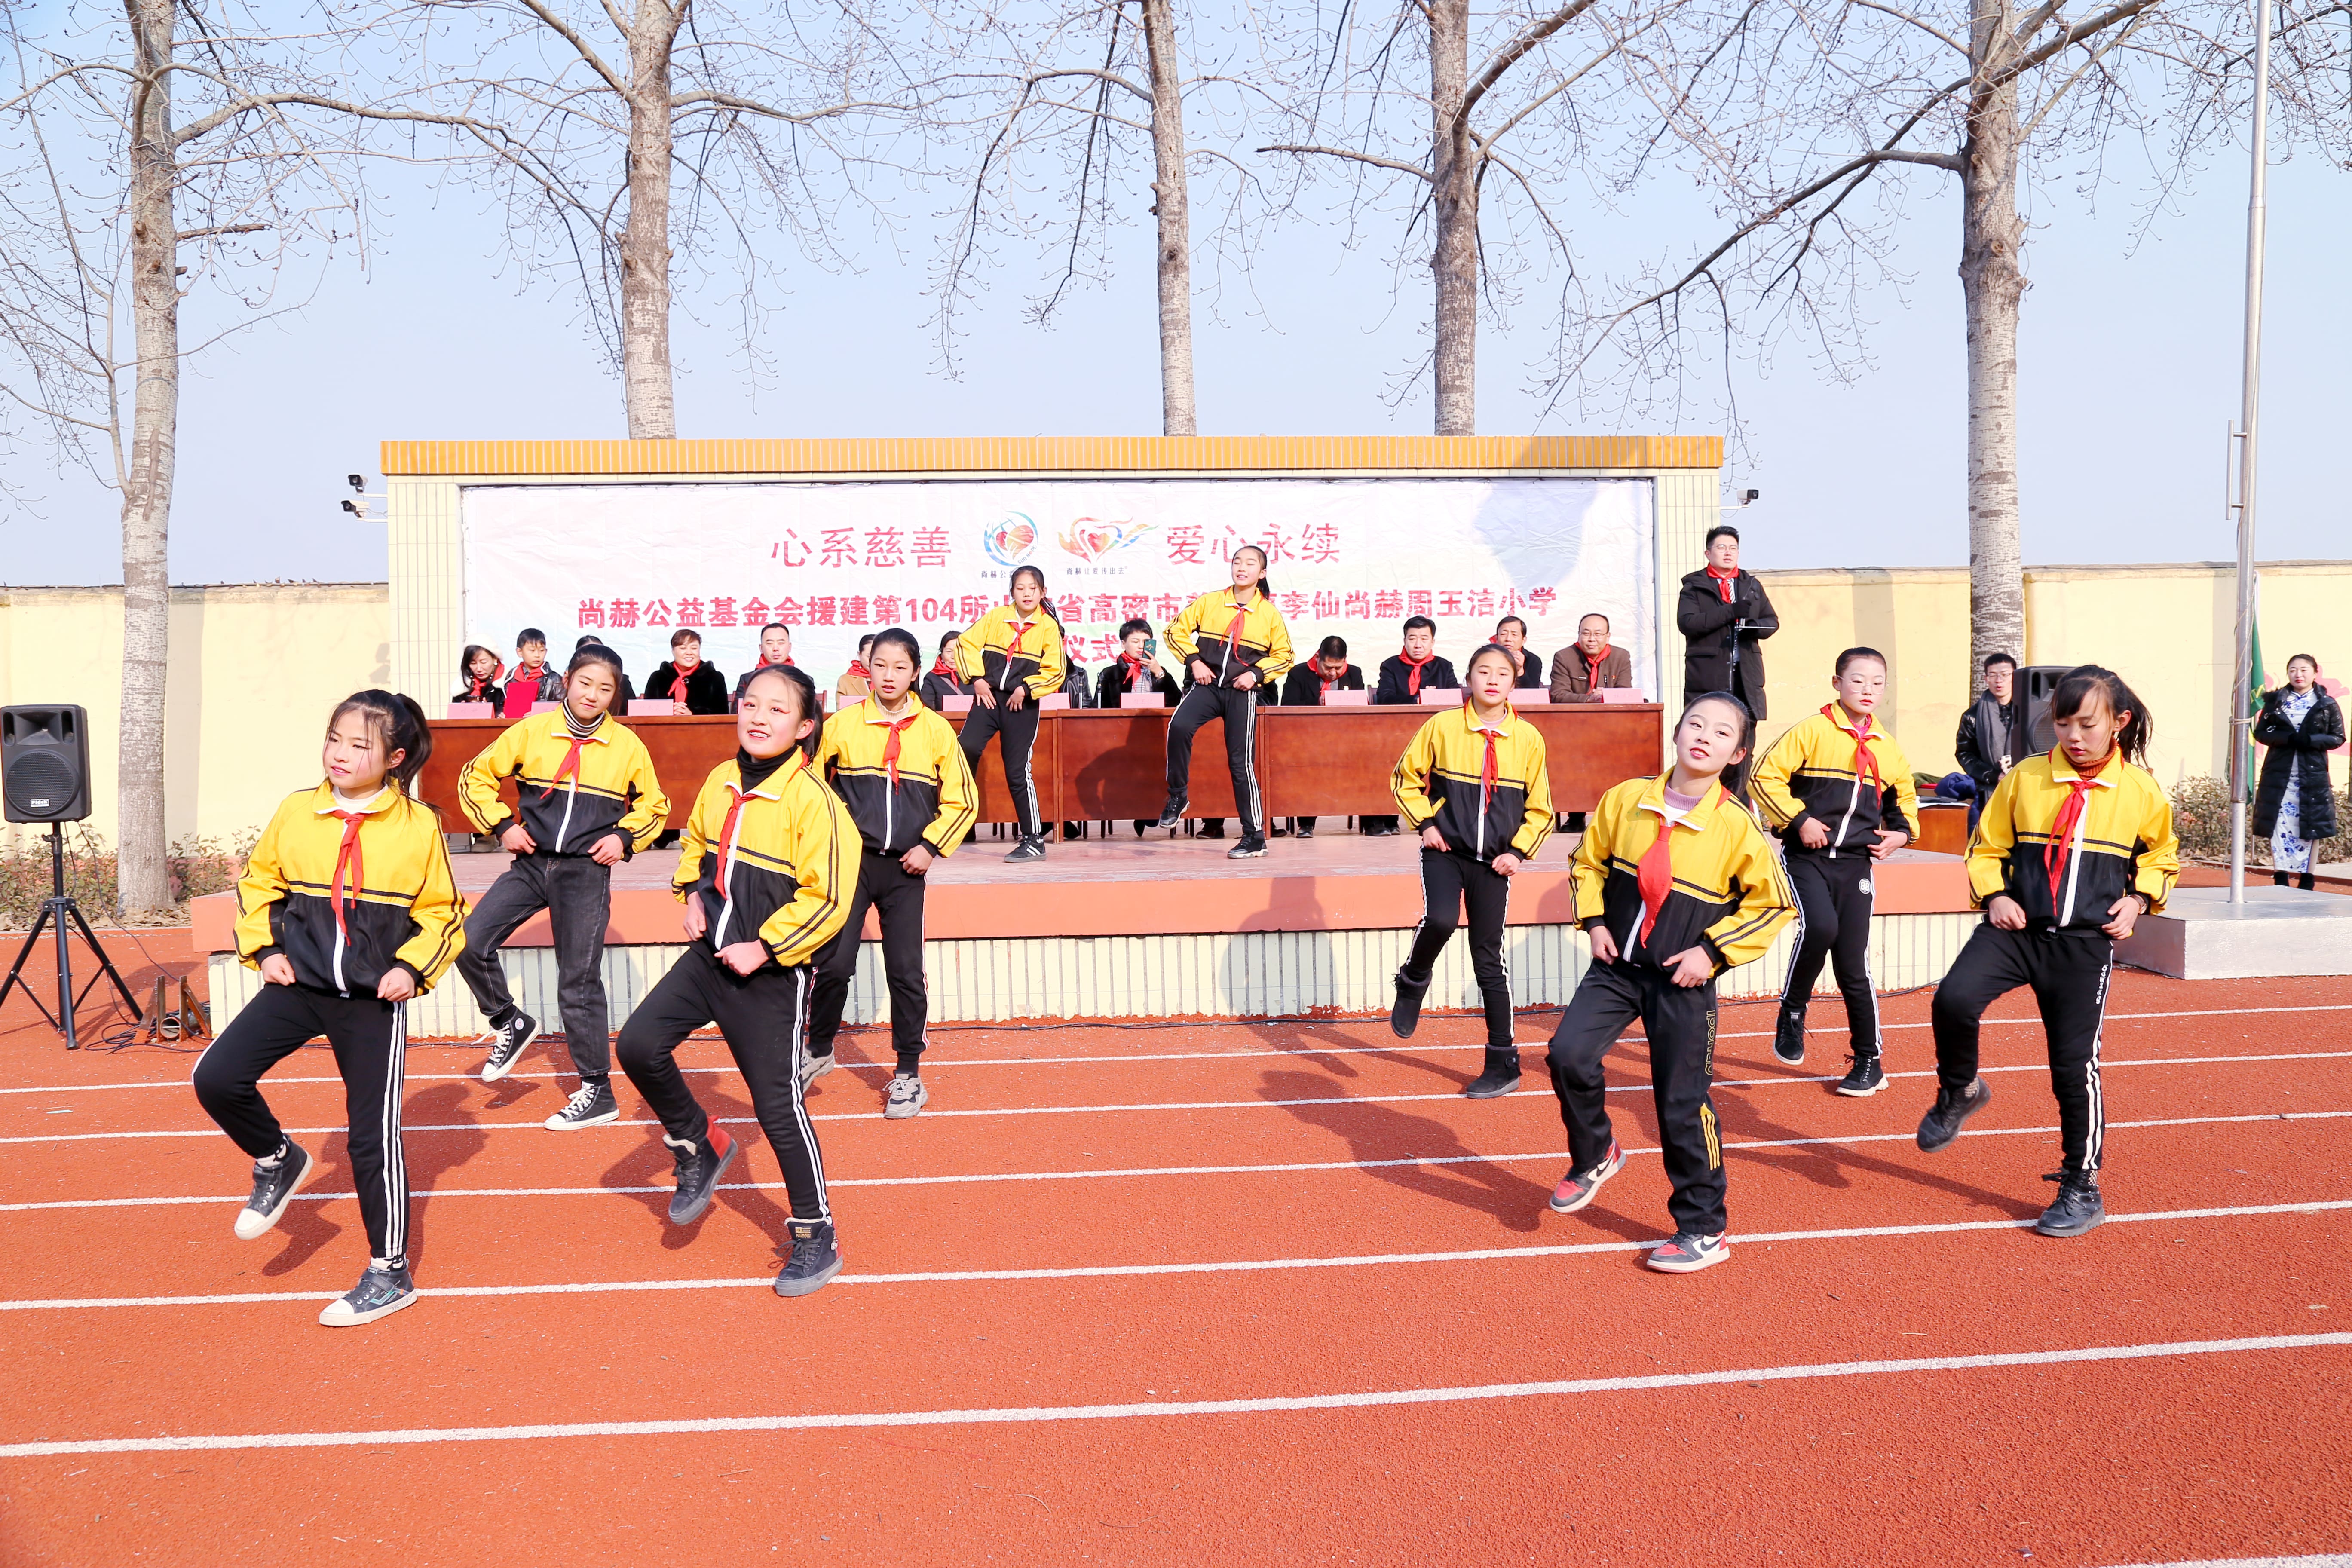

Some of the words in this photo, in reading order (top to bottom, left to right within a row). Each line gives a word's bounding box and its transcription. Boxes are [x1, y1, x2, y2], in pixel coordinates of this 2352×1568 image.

[771, 526, 951, 568] 心系慈善
[1167, 523, 1340, 564] 爱心永续
